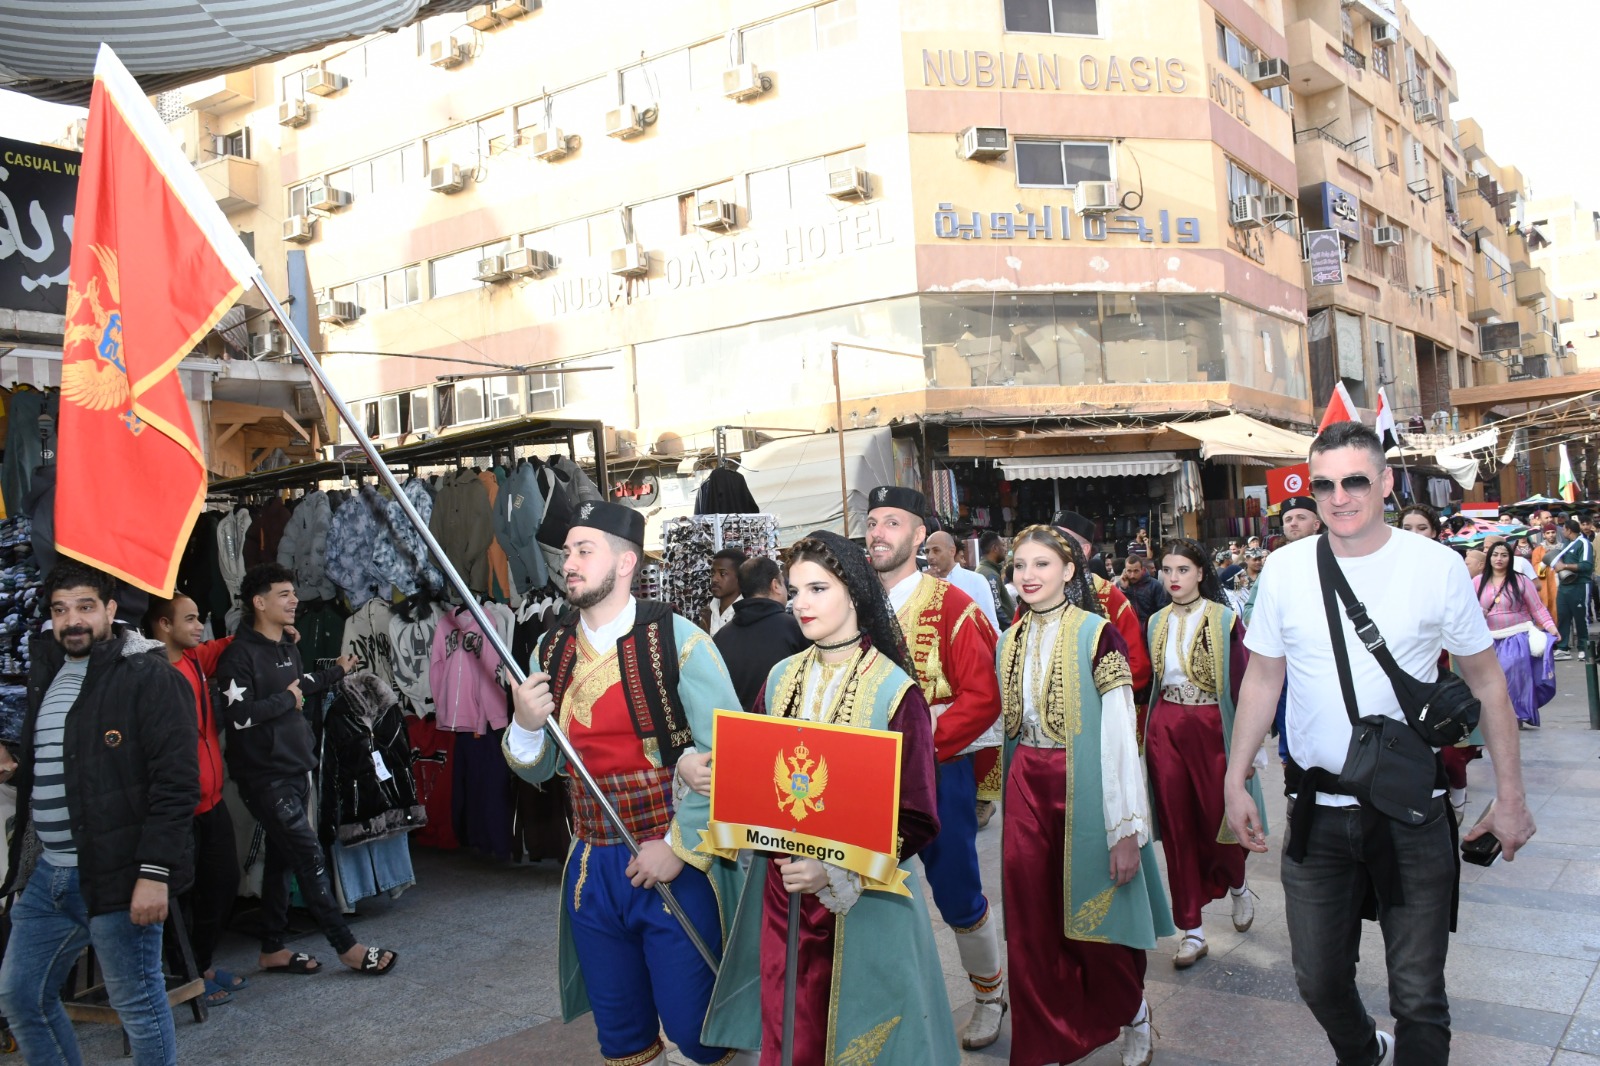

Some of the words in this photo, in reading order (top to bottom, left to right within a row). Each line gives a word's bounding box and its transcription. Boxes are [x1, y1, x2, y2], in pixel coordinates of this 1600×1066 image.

[921, 48, 1061, 91] NUBIAN
[1078, 54, 1188, 94] OASIS
[1206, 63, 1251, 127] HOTEL
[4, 151, 62, 174] CASUAL
[666, 238, 761, 290] OASIS
[784, 207, 895, 266] HOTEL
[746, 828, 845, 861] Montenegro
